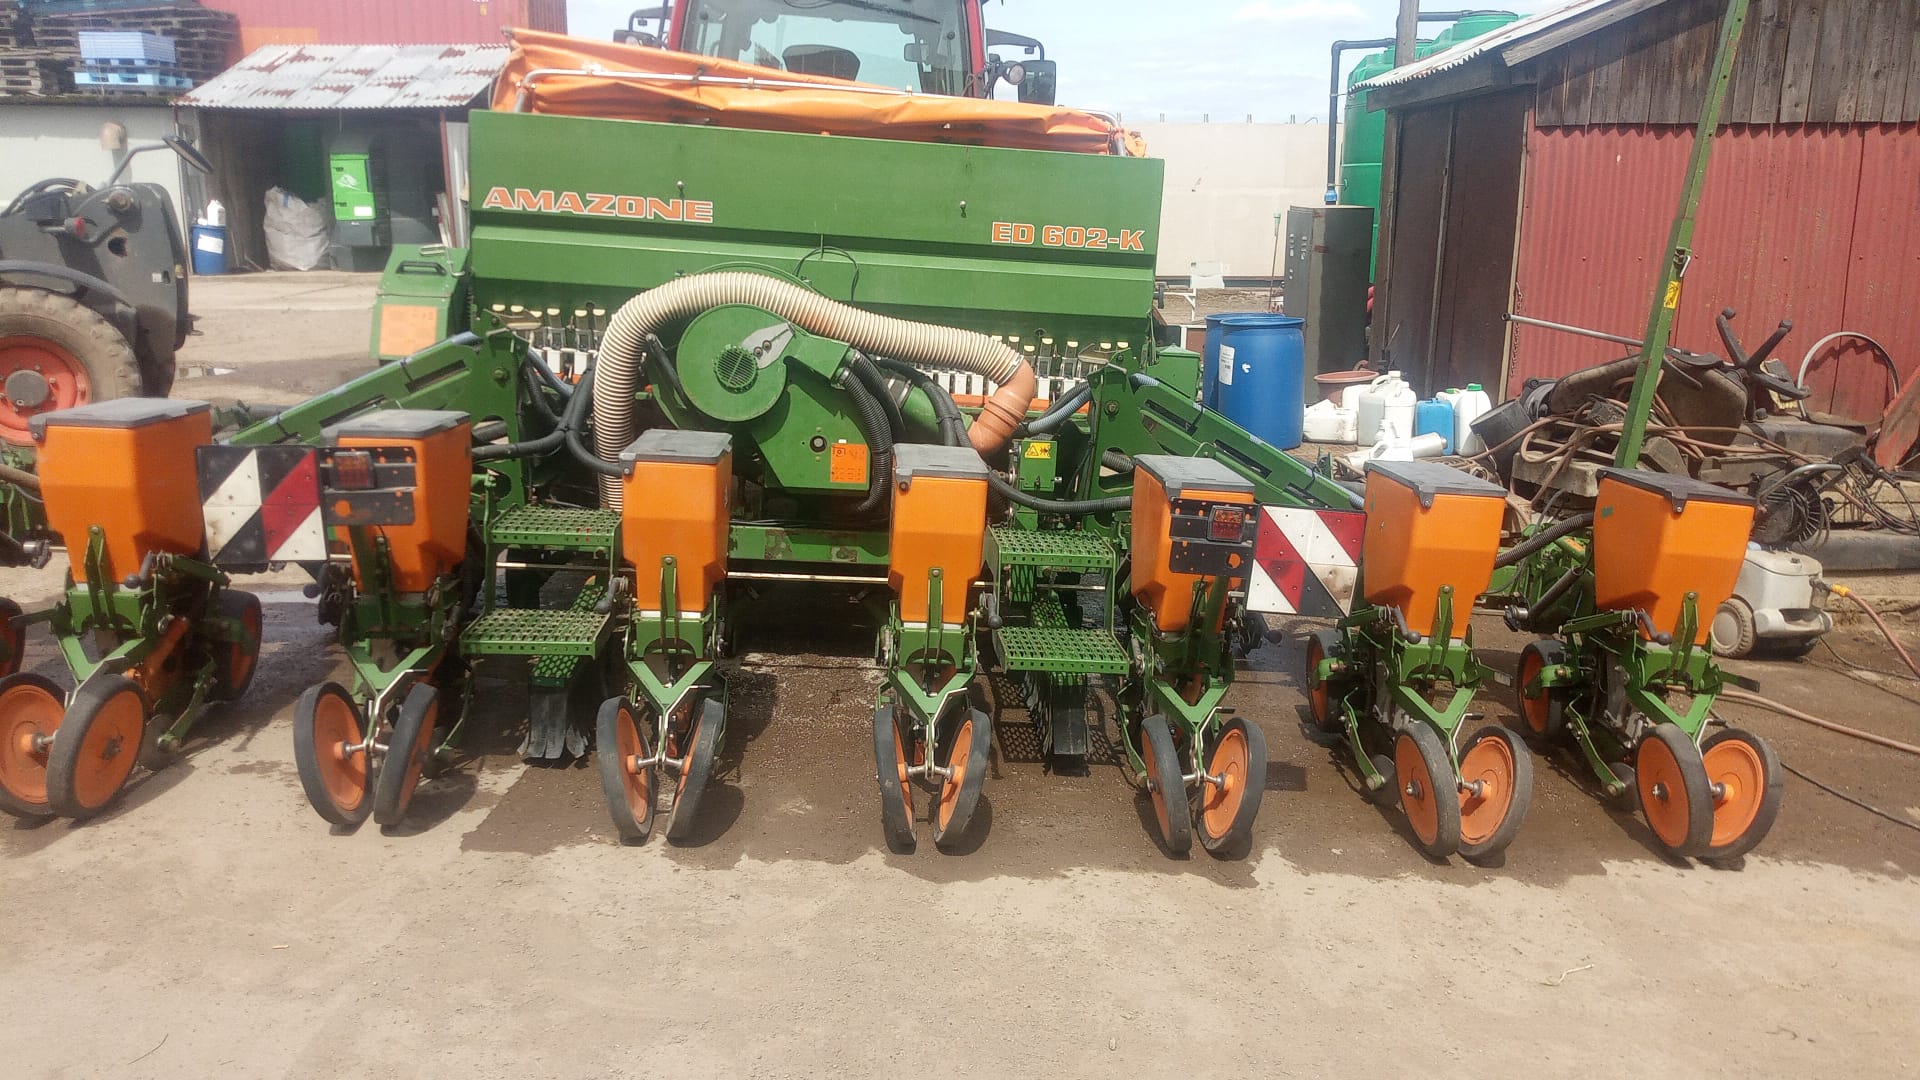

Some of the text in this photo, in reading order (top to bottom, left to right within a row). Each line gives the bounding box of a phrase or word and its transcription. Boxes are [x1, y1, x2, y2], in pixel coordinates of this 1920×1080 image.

[482, 186, 714, 224] AMAZONE
[991, 221, 1146, 251] ED 602-K
